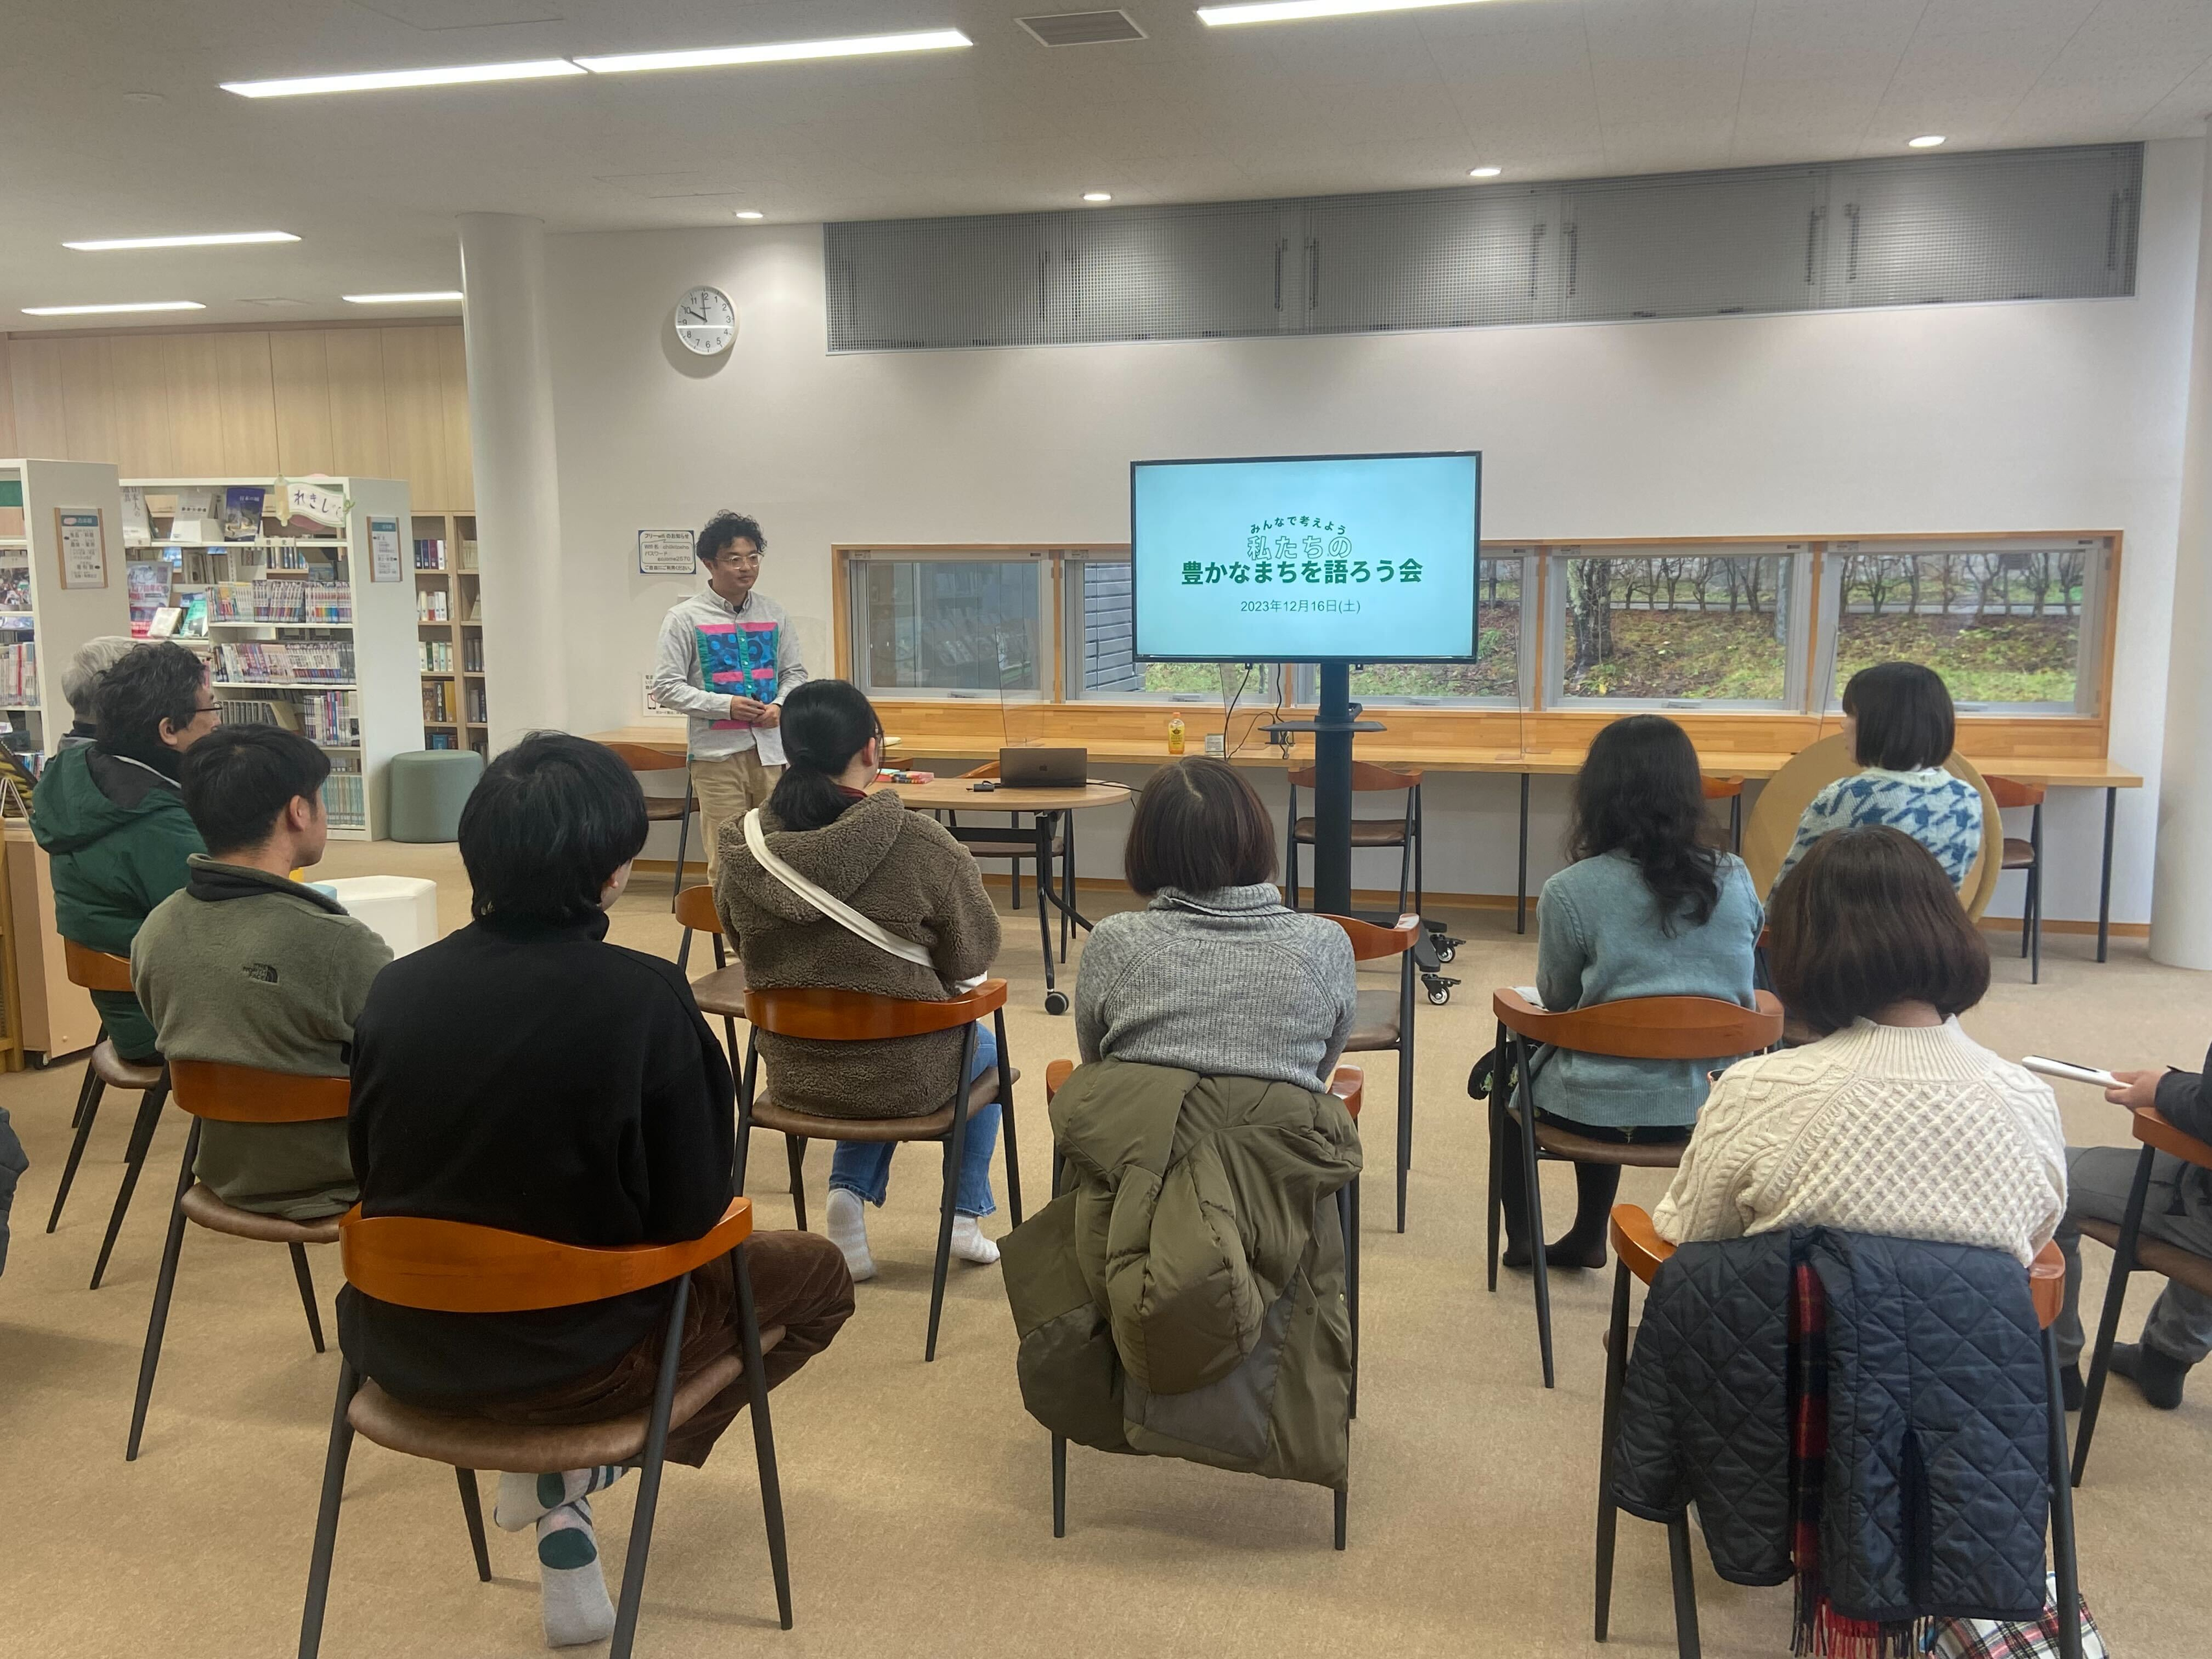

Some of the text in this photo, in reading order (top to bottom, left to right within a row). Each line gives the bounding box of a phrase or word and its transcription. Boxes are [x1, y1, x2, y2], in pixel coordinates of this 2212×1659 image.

[1250, 515, 1346, 535] みんなで考えよう
[1247, 535, 1353, 561] 私たちの
[1181, 558, 1423, 585] 豊かなまちを語ろう会
[1240, 599, 1361, 614] 2023年12月16日(土)
